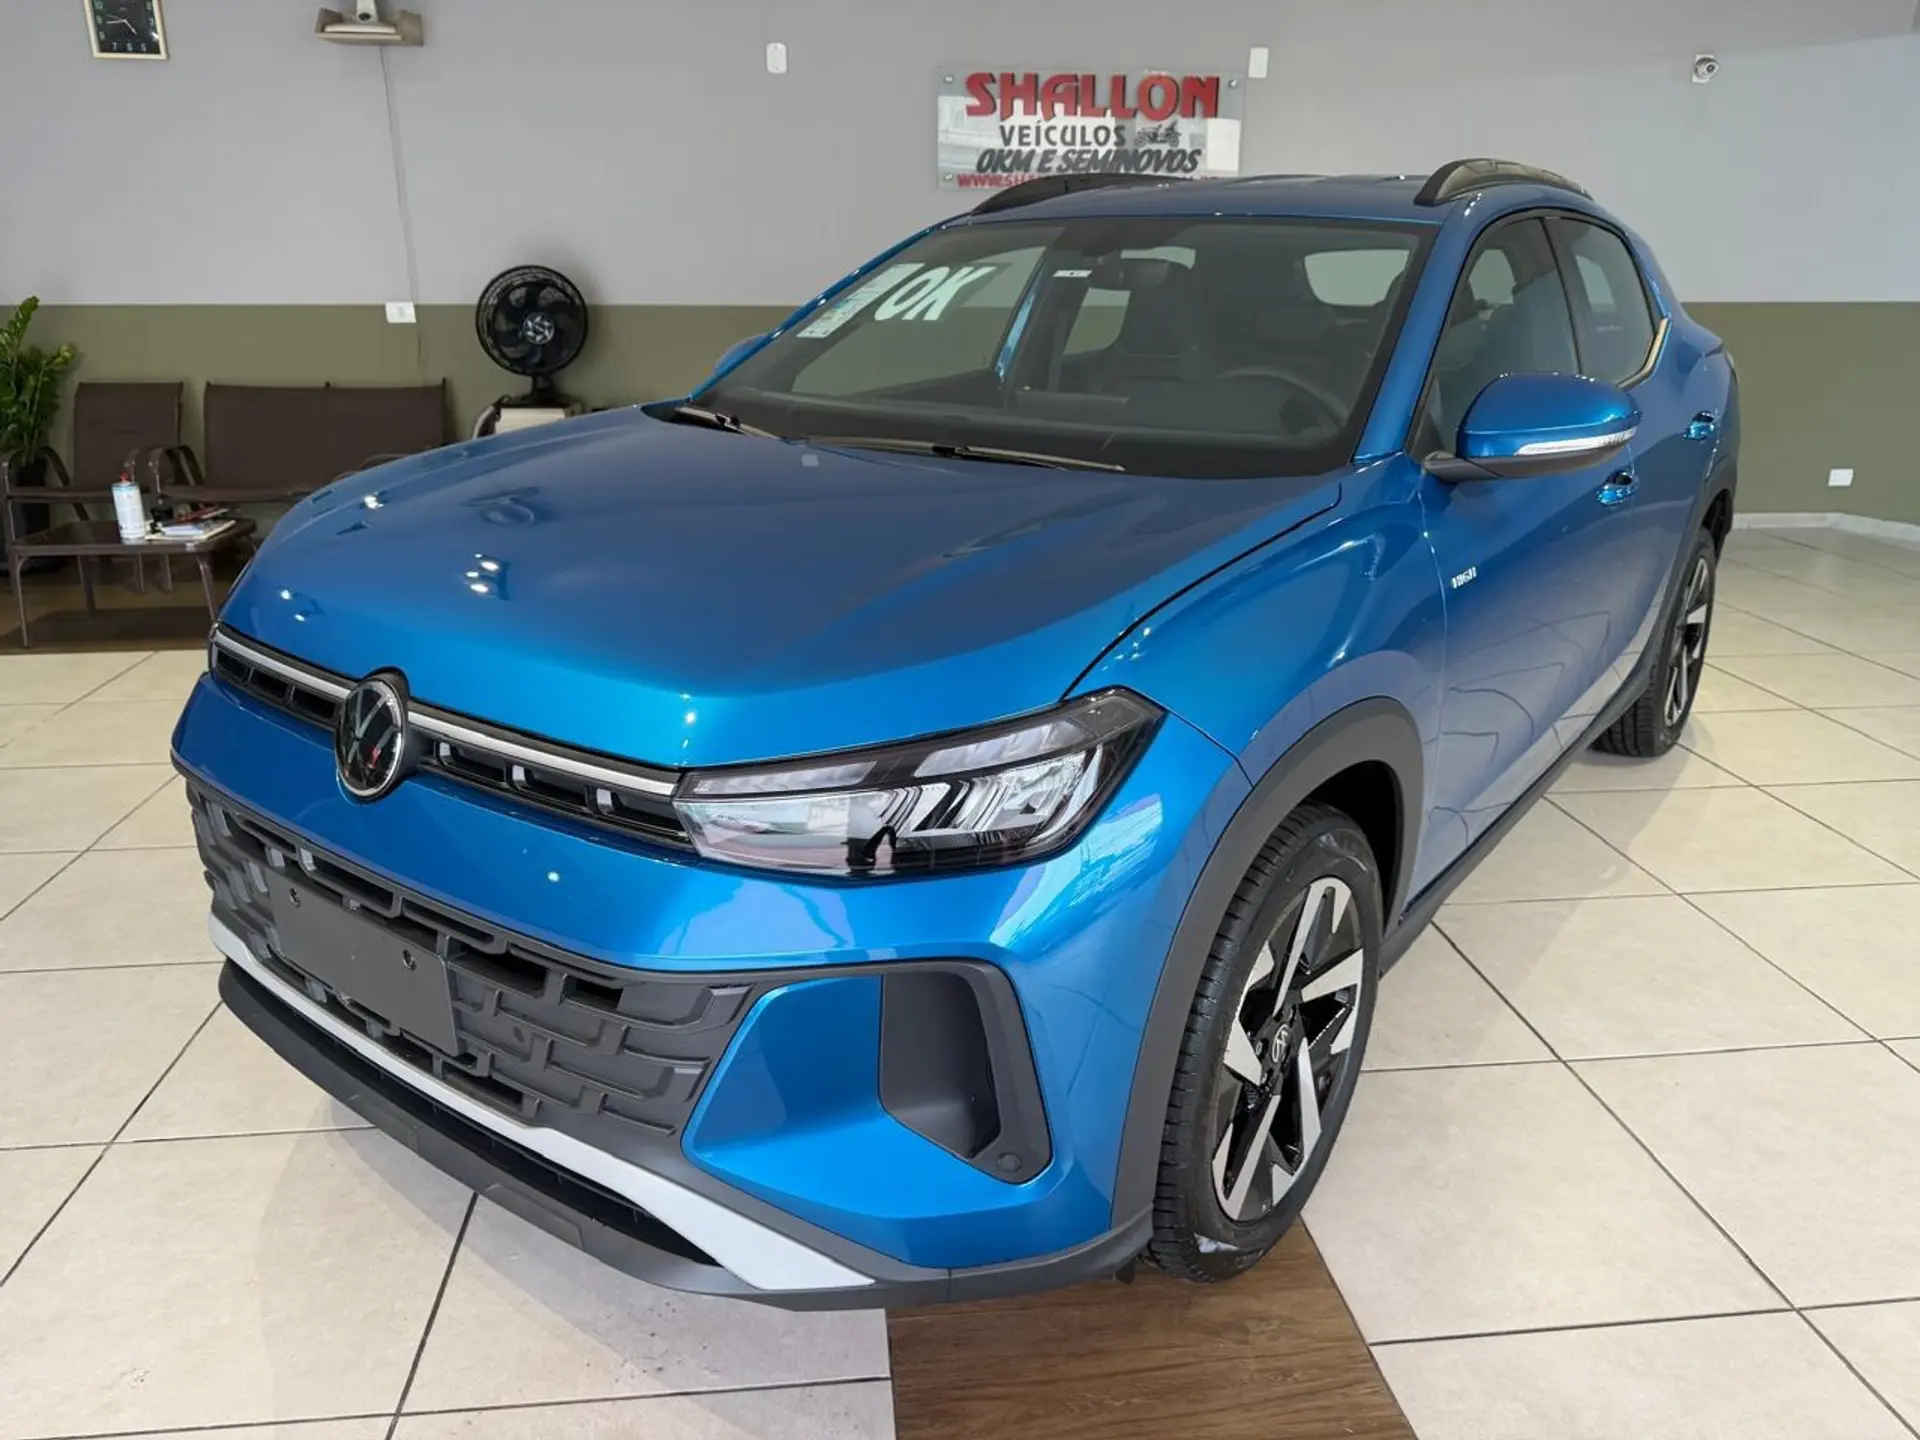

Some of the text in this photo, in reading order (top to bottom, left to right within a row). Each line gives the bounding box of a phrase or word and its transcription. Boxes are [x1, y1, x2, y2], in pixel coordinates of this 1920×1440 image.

[965, 72, 1220, 121] SHALLON
[1000, 120, 1126, 147] VEÍCULOS
[1037, 148, 1055, 173] E
[1056, 148, 1202, 174] SEMINOVOS
